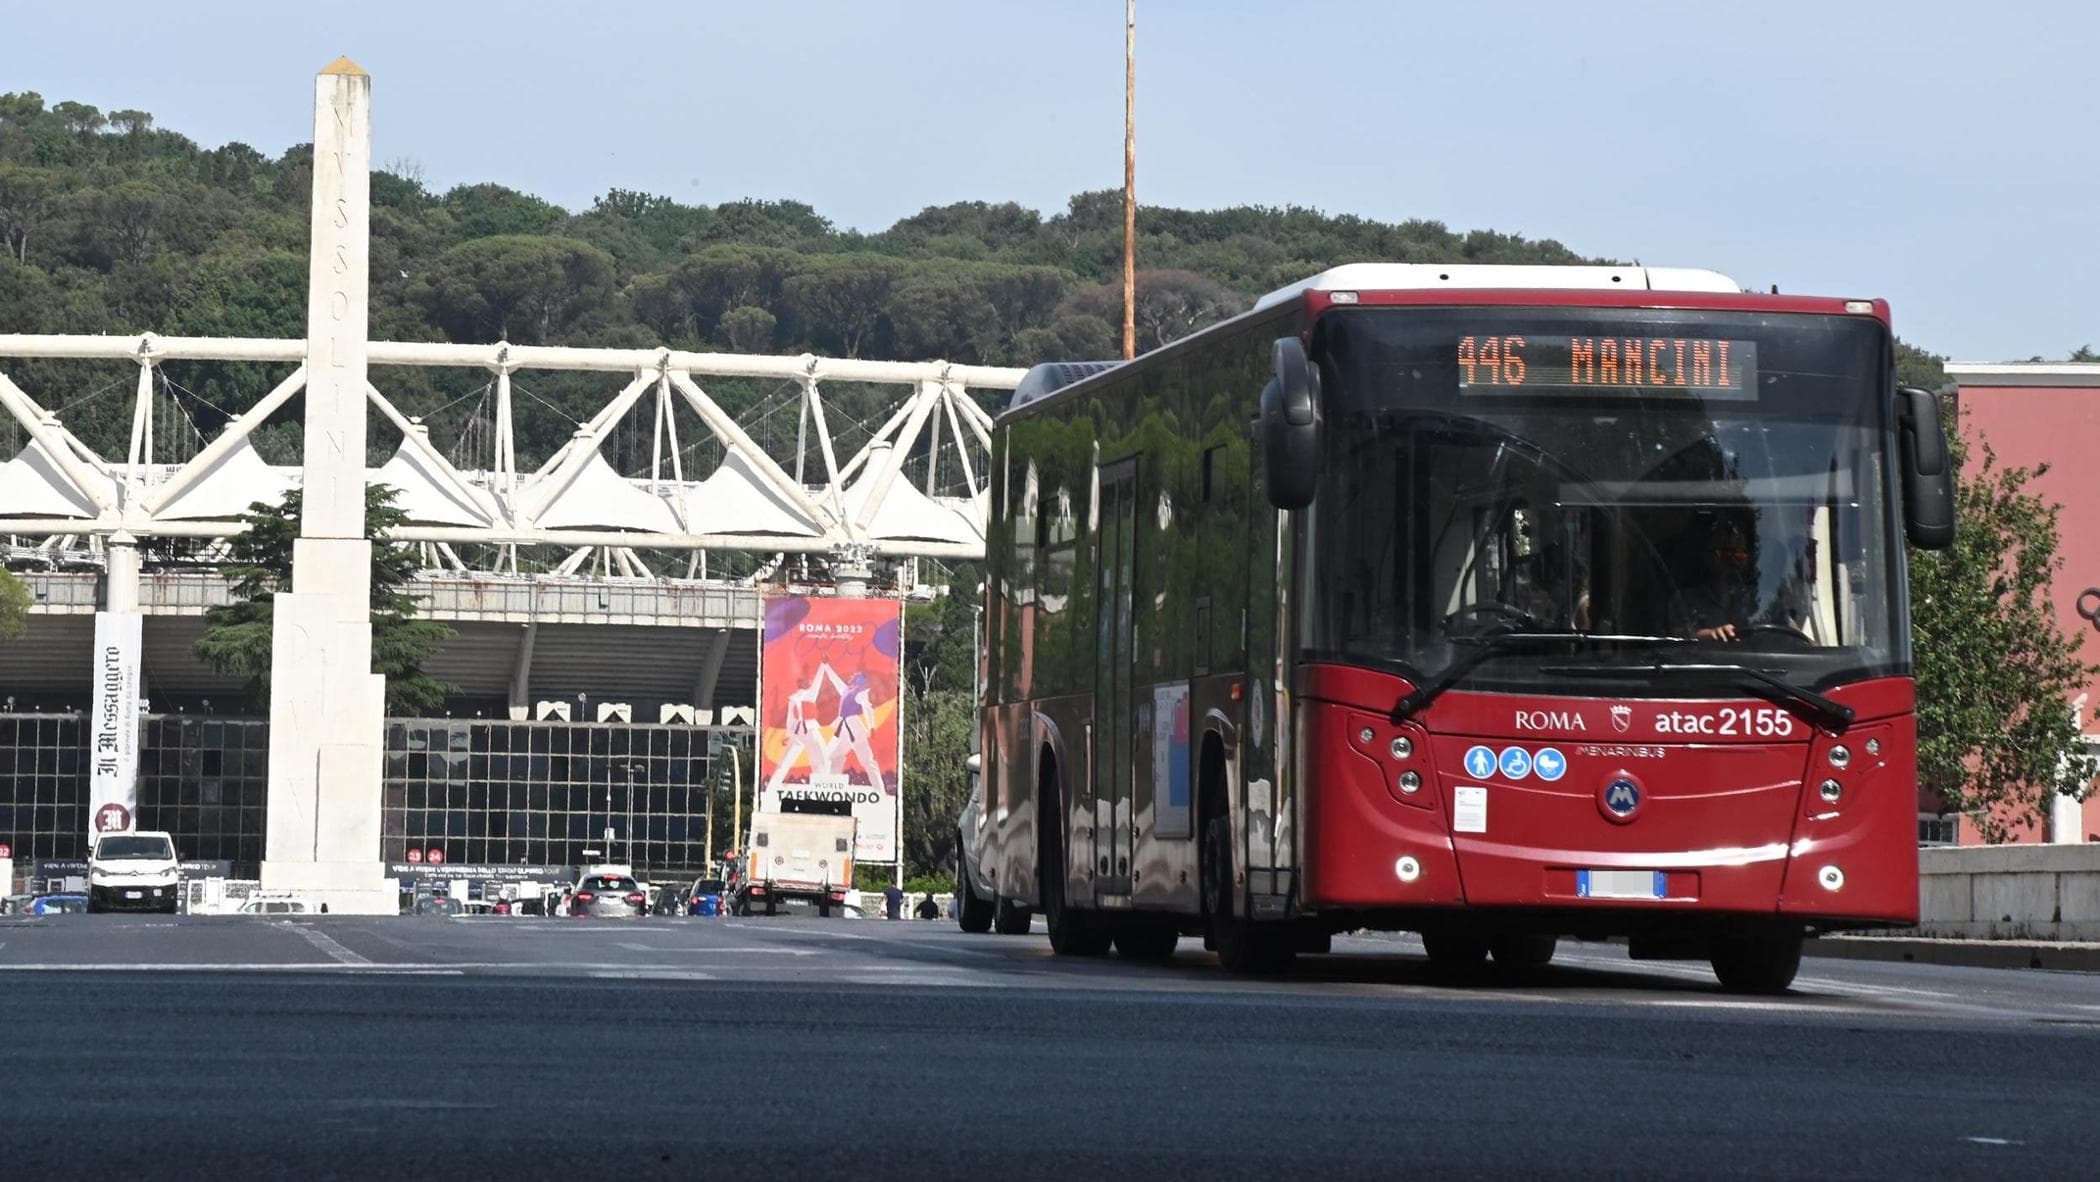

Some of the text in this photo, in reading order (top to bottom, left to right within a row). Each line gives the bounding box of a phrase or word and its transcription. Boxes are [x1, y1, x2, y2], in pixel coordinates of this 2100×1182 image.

[1457, 336, 1730, 386] 446 MANCINI
[799, 624, 832, 633] ROMA
[97, 646, 123, 778] Il Messaggero
[1515, 710, 1587, 731] ROMA
[1654, 708, 1792, 736] atac 2155
[815, 782, 844, 790] WORLD
[777, 790, 880, 804] TAEKWONDO
